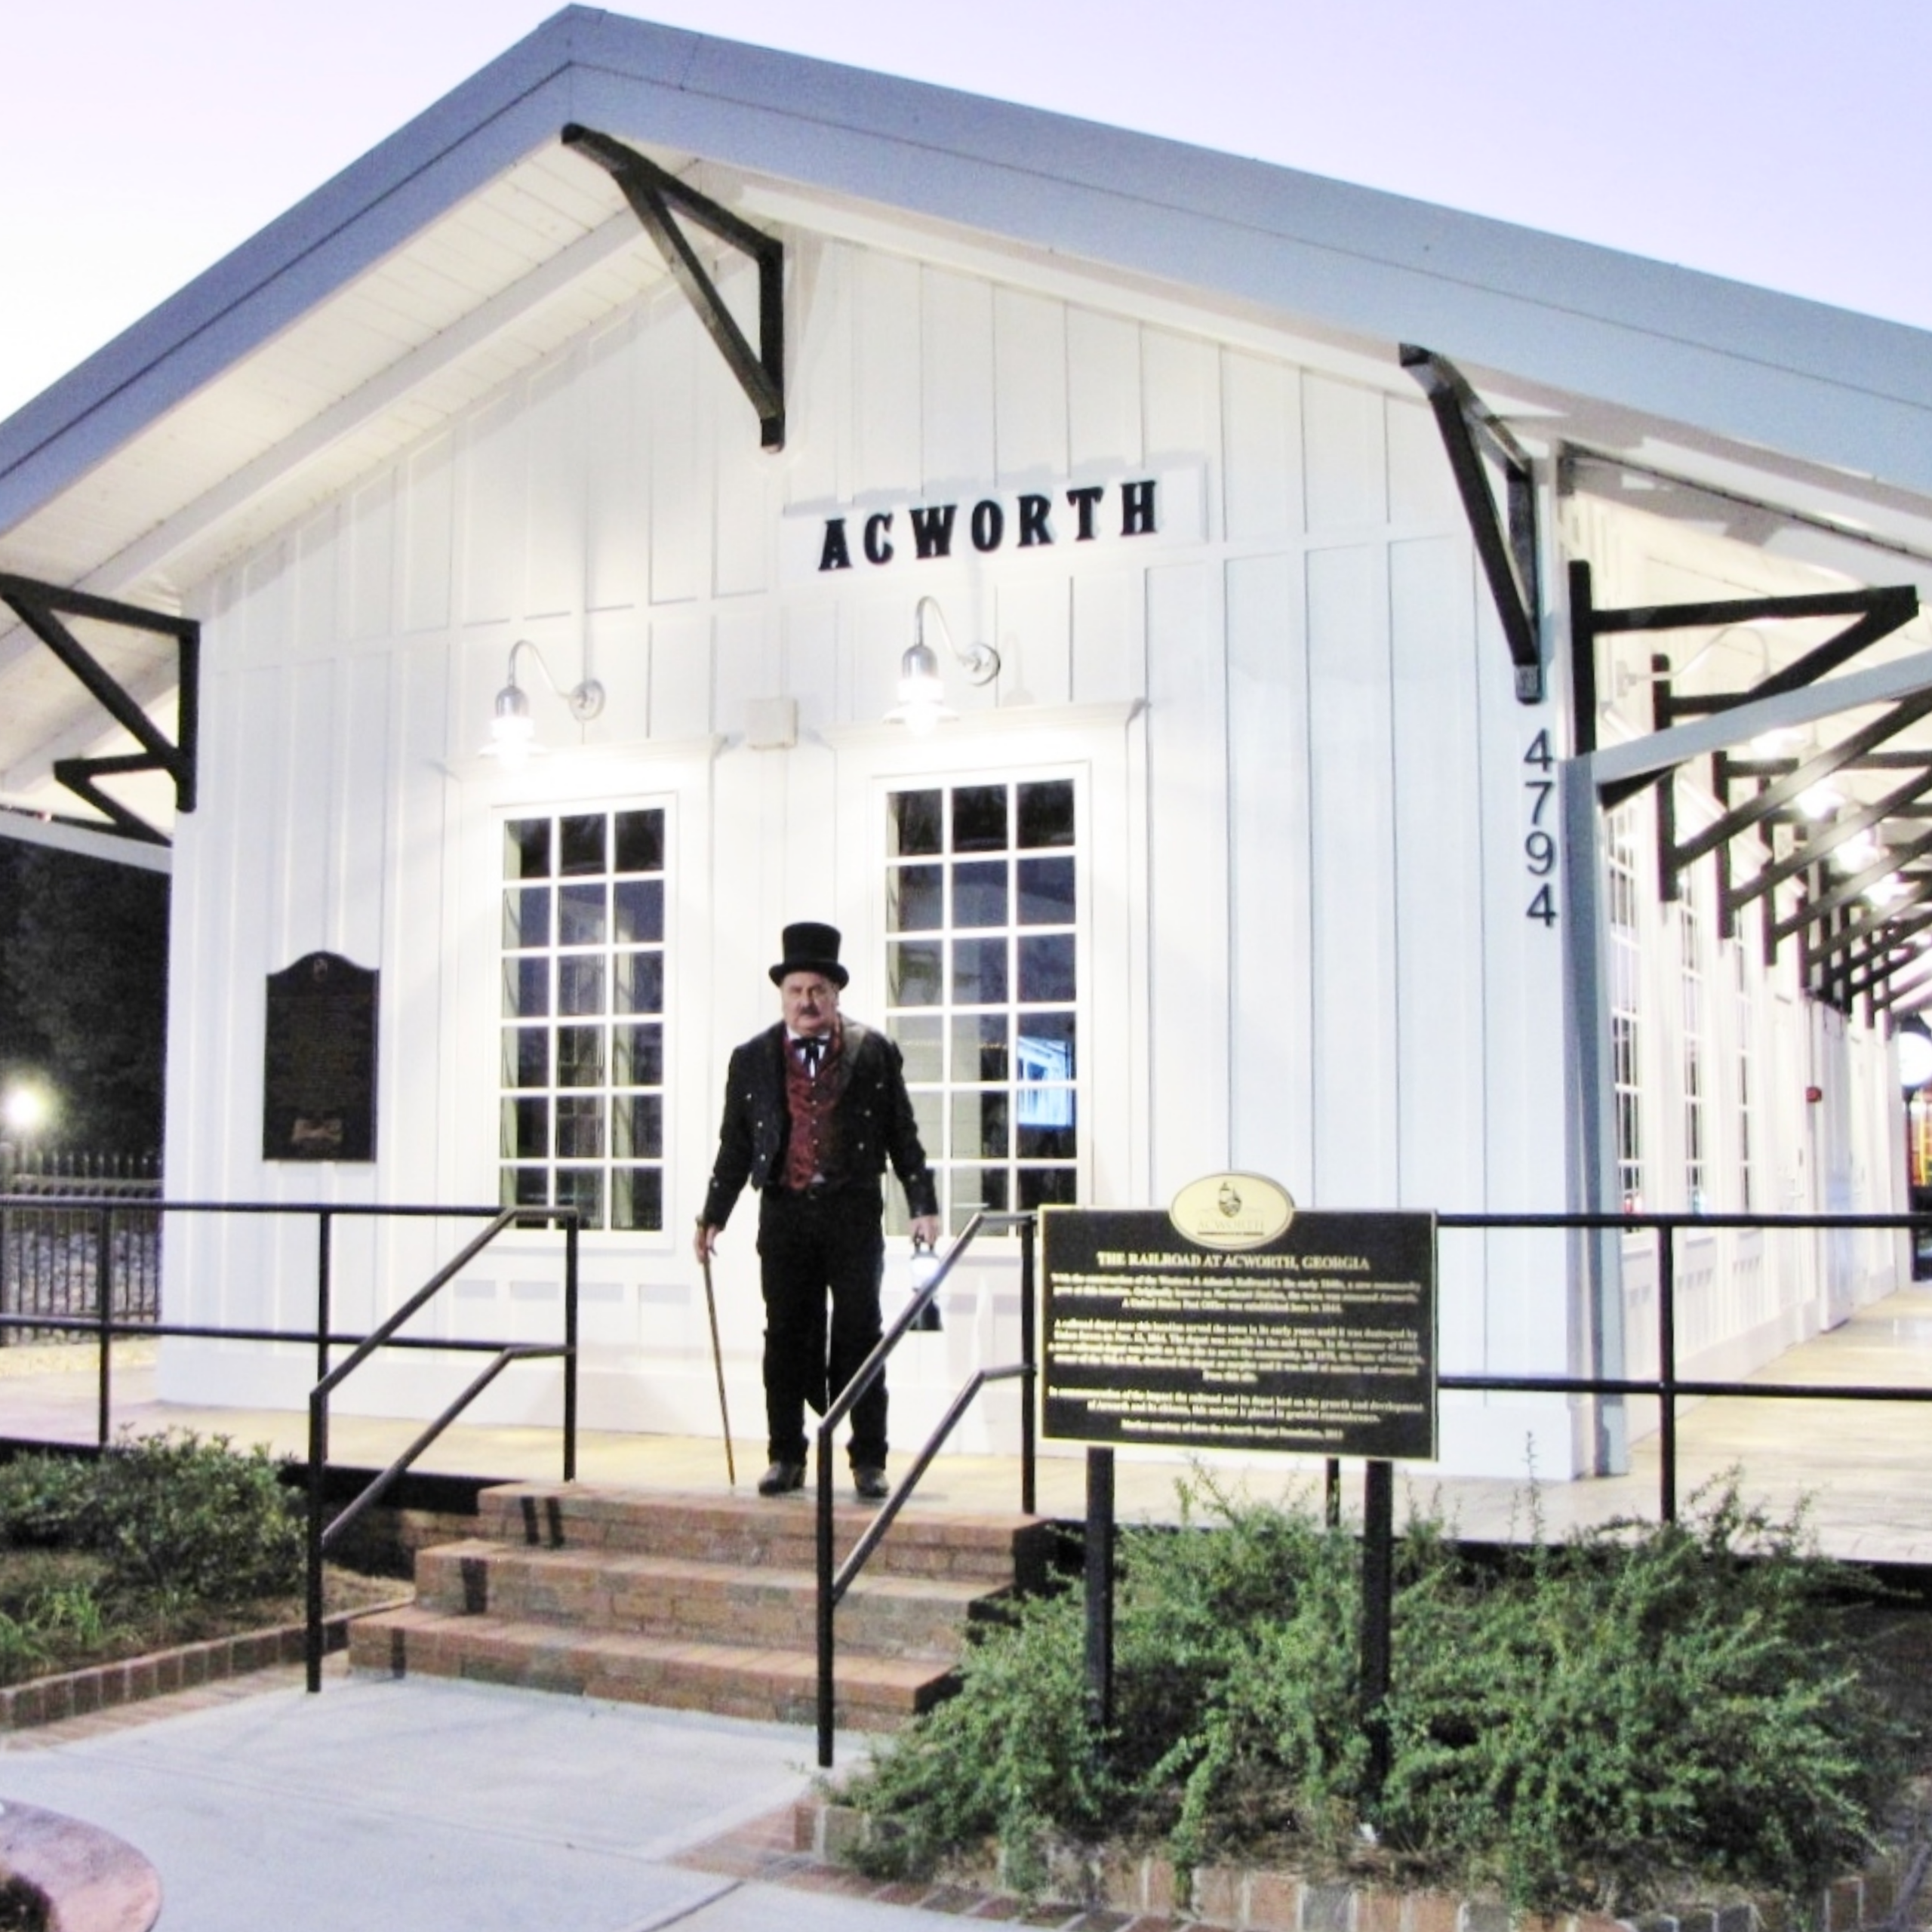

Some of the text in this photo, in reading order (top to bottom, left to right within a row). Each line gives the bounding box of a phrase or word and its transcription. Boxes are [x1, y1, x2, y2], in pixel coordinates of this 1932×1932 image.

[818, 480, 1157, 571] ACWORTH
[1524, 728, 1557, 928] 4794
[1097, 1251, 1127, 1266] THE
[1128, 1251, 1201, 1267] RAILROAD
[1203, 1254, 1223, 1268] AT
[1302, 1255, 1371, 1271] GEORGIA
